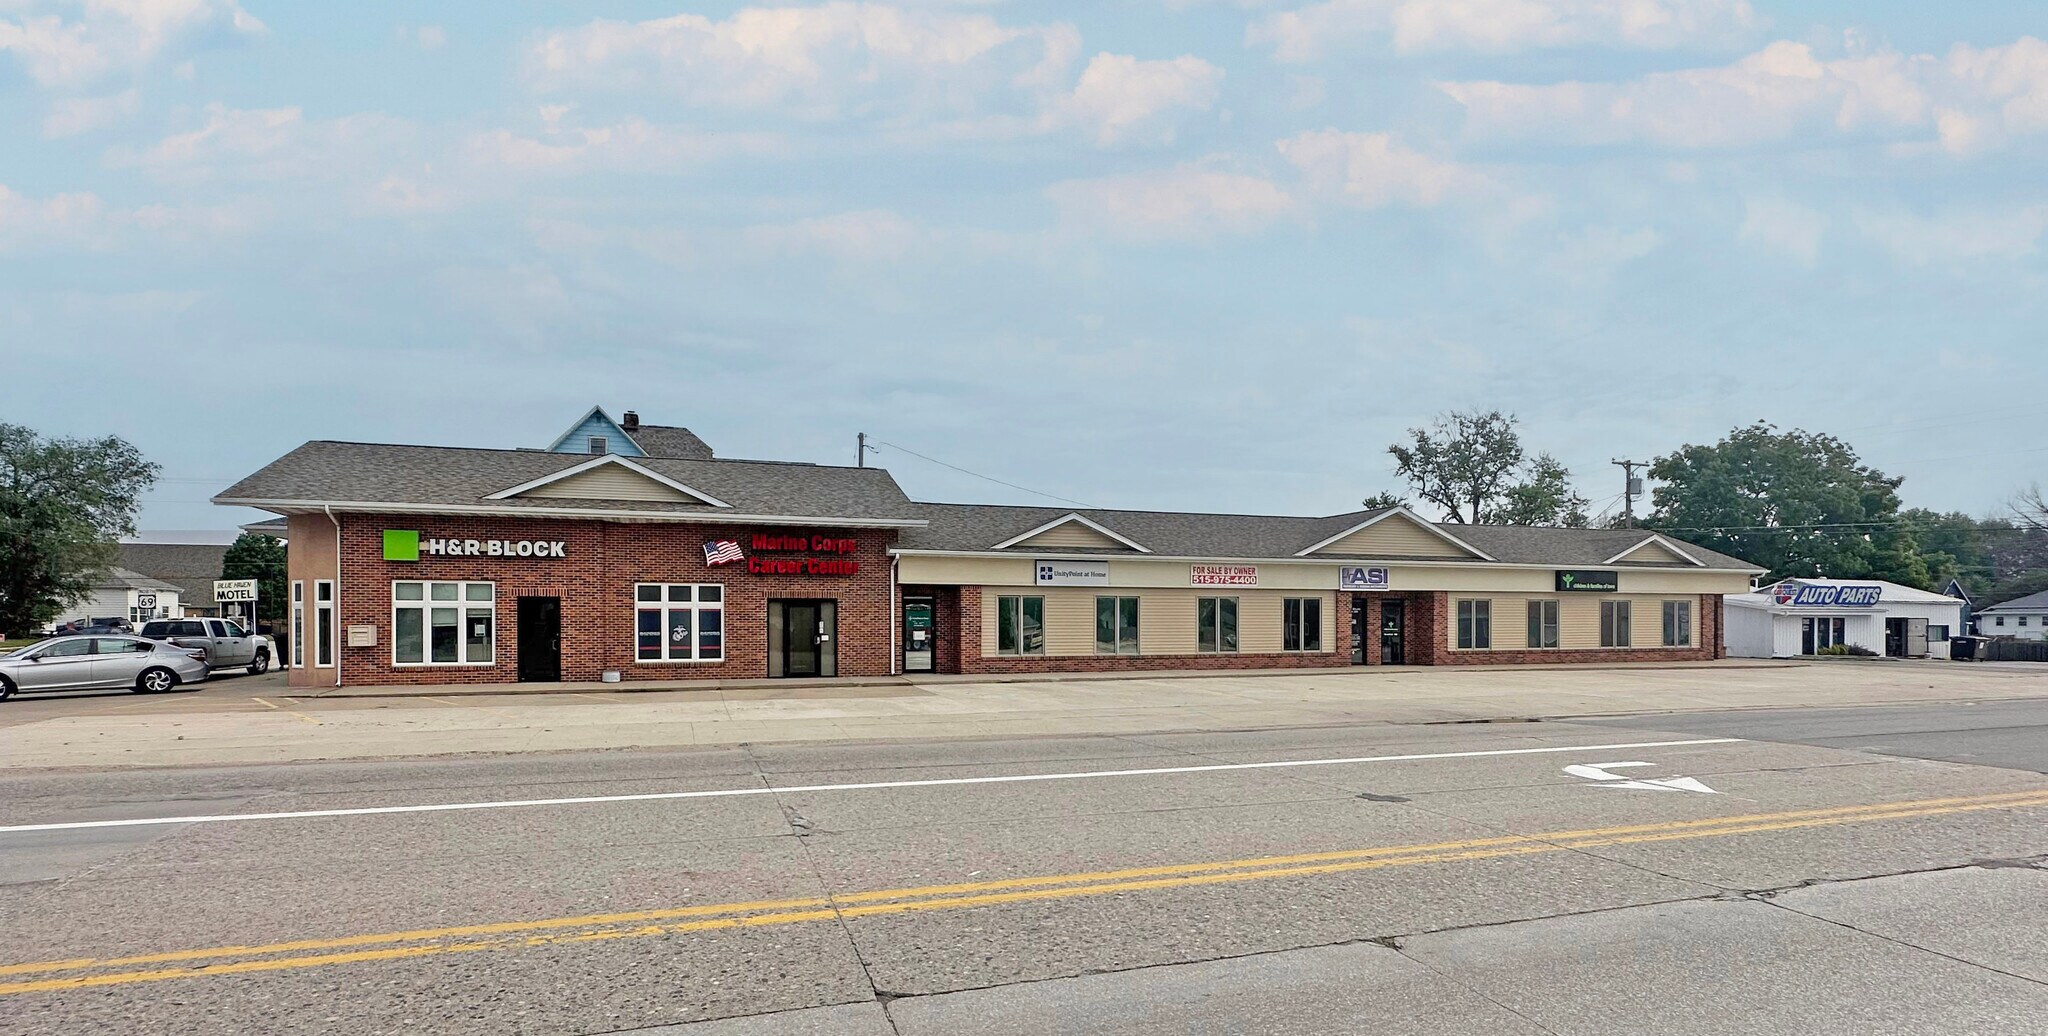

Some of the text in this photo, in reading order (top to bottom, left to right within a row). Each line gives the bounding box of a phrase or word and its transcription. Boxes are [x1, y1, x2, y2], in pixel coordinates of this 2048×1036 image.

[429, 538, 566, 557] H&R BLOCK
[752, 534, 857, 554] Marine Corps
[748, 557, 859, 575] Career Center
[1193, 566, 1256, 575] FOR SALE BY OWNER
[1193, 575, 1256, 584] 515-975-4400
[1350, 568, 1388, 583] ASI
[140, 598, 154, 606] 69
[216, 590, 255, 600] MOTEL
[1798, 587, 1881, 603] AUTO PARTS
